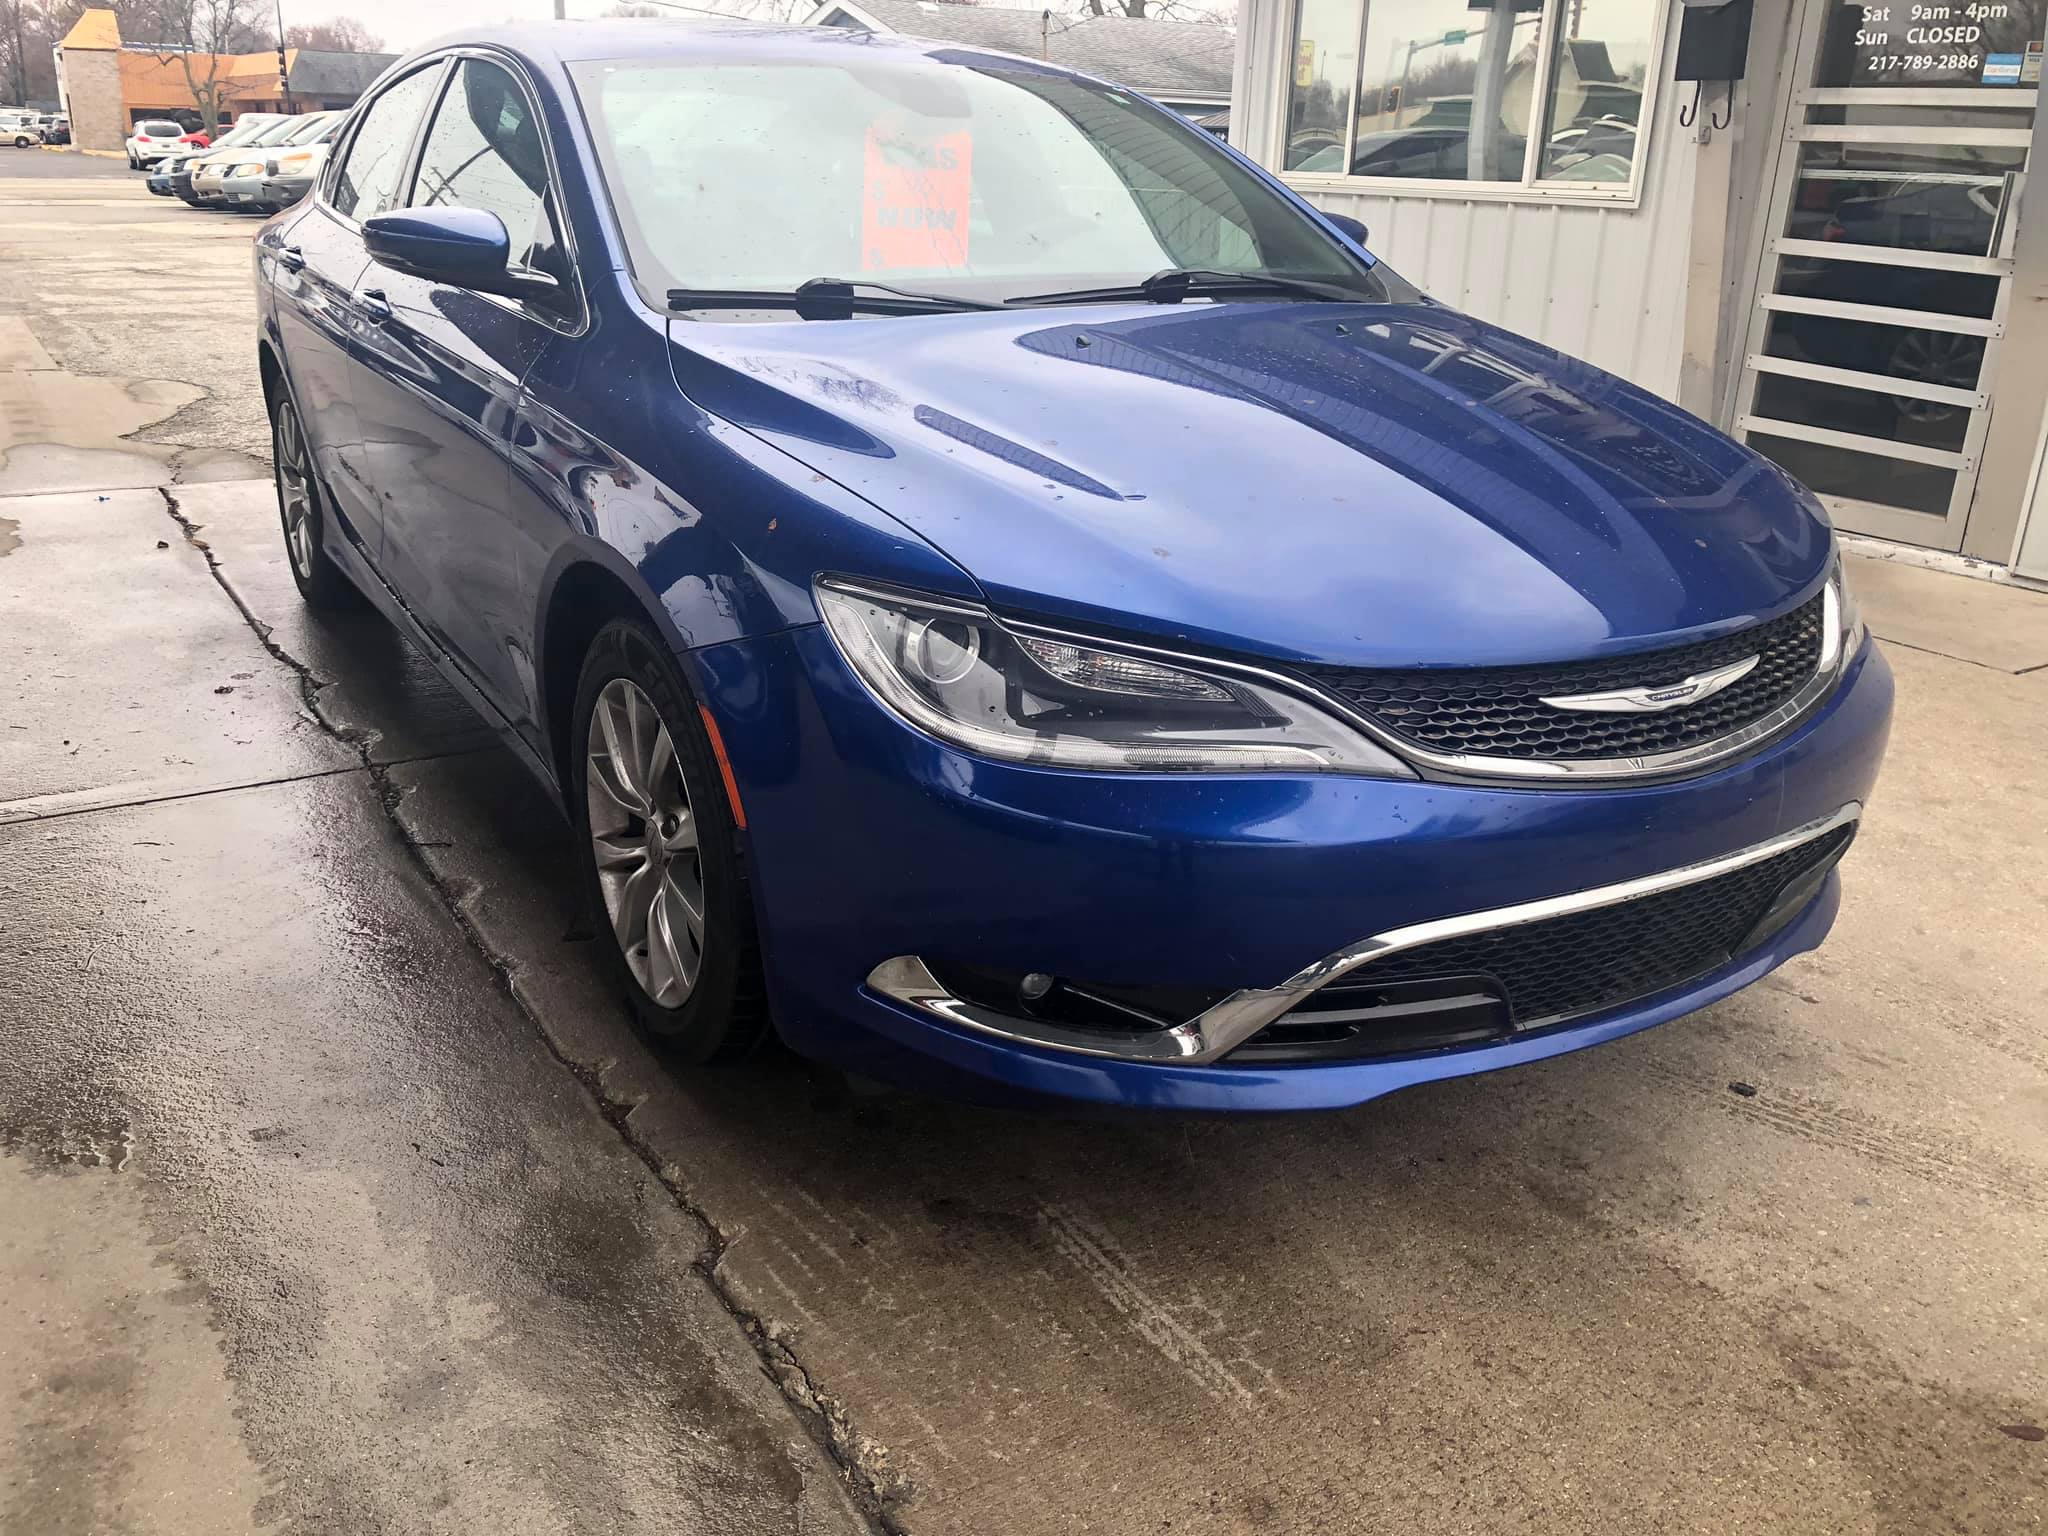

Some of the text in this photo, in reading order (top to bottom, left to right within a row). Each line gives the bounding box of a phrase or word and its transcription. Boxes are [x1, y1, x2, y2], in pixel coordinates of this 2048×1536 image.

[1862, 6, 1890, 22] Sat
[1911, 4, 1950, 21] 9am
[1965, 2, 2008, 22] 4pm
[1855, 26, 1980, 46] Sun CLOSED
[1868, 54, 1979, 71] 217-789-2886
[1651, 687, 1694, 700] CHRYSLER
